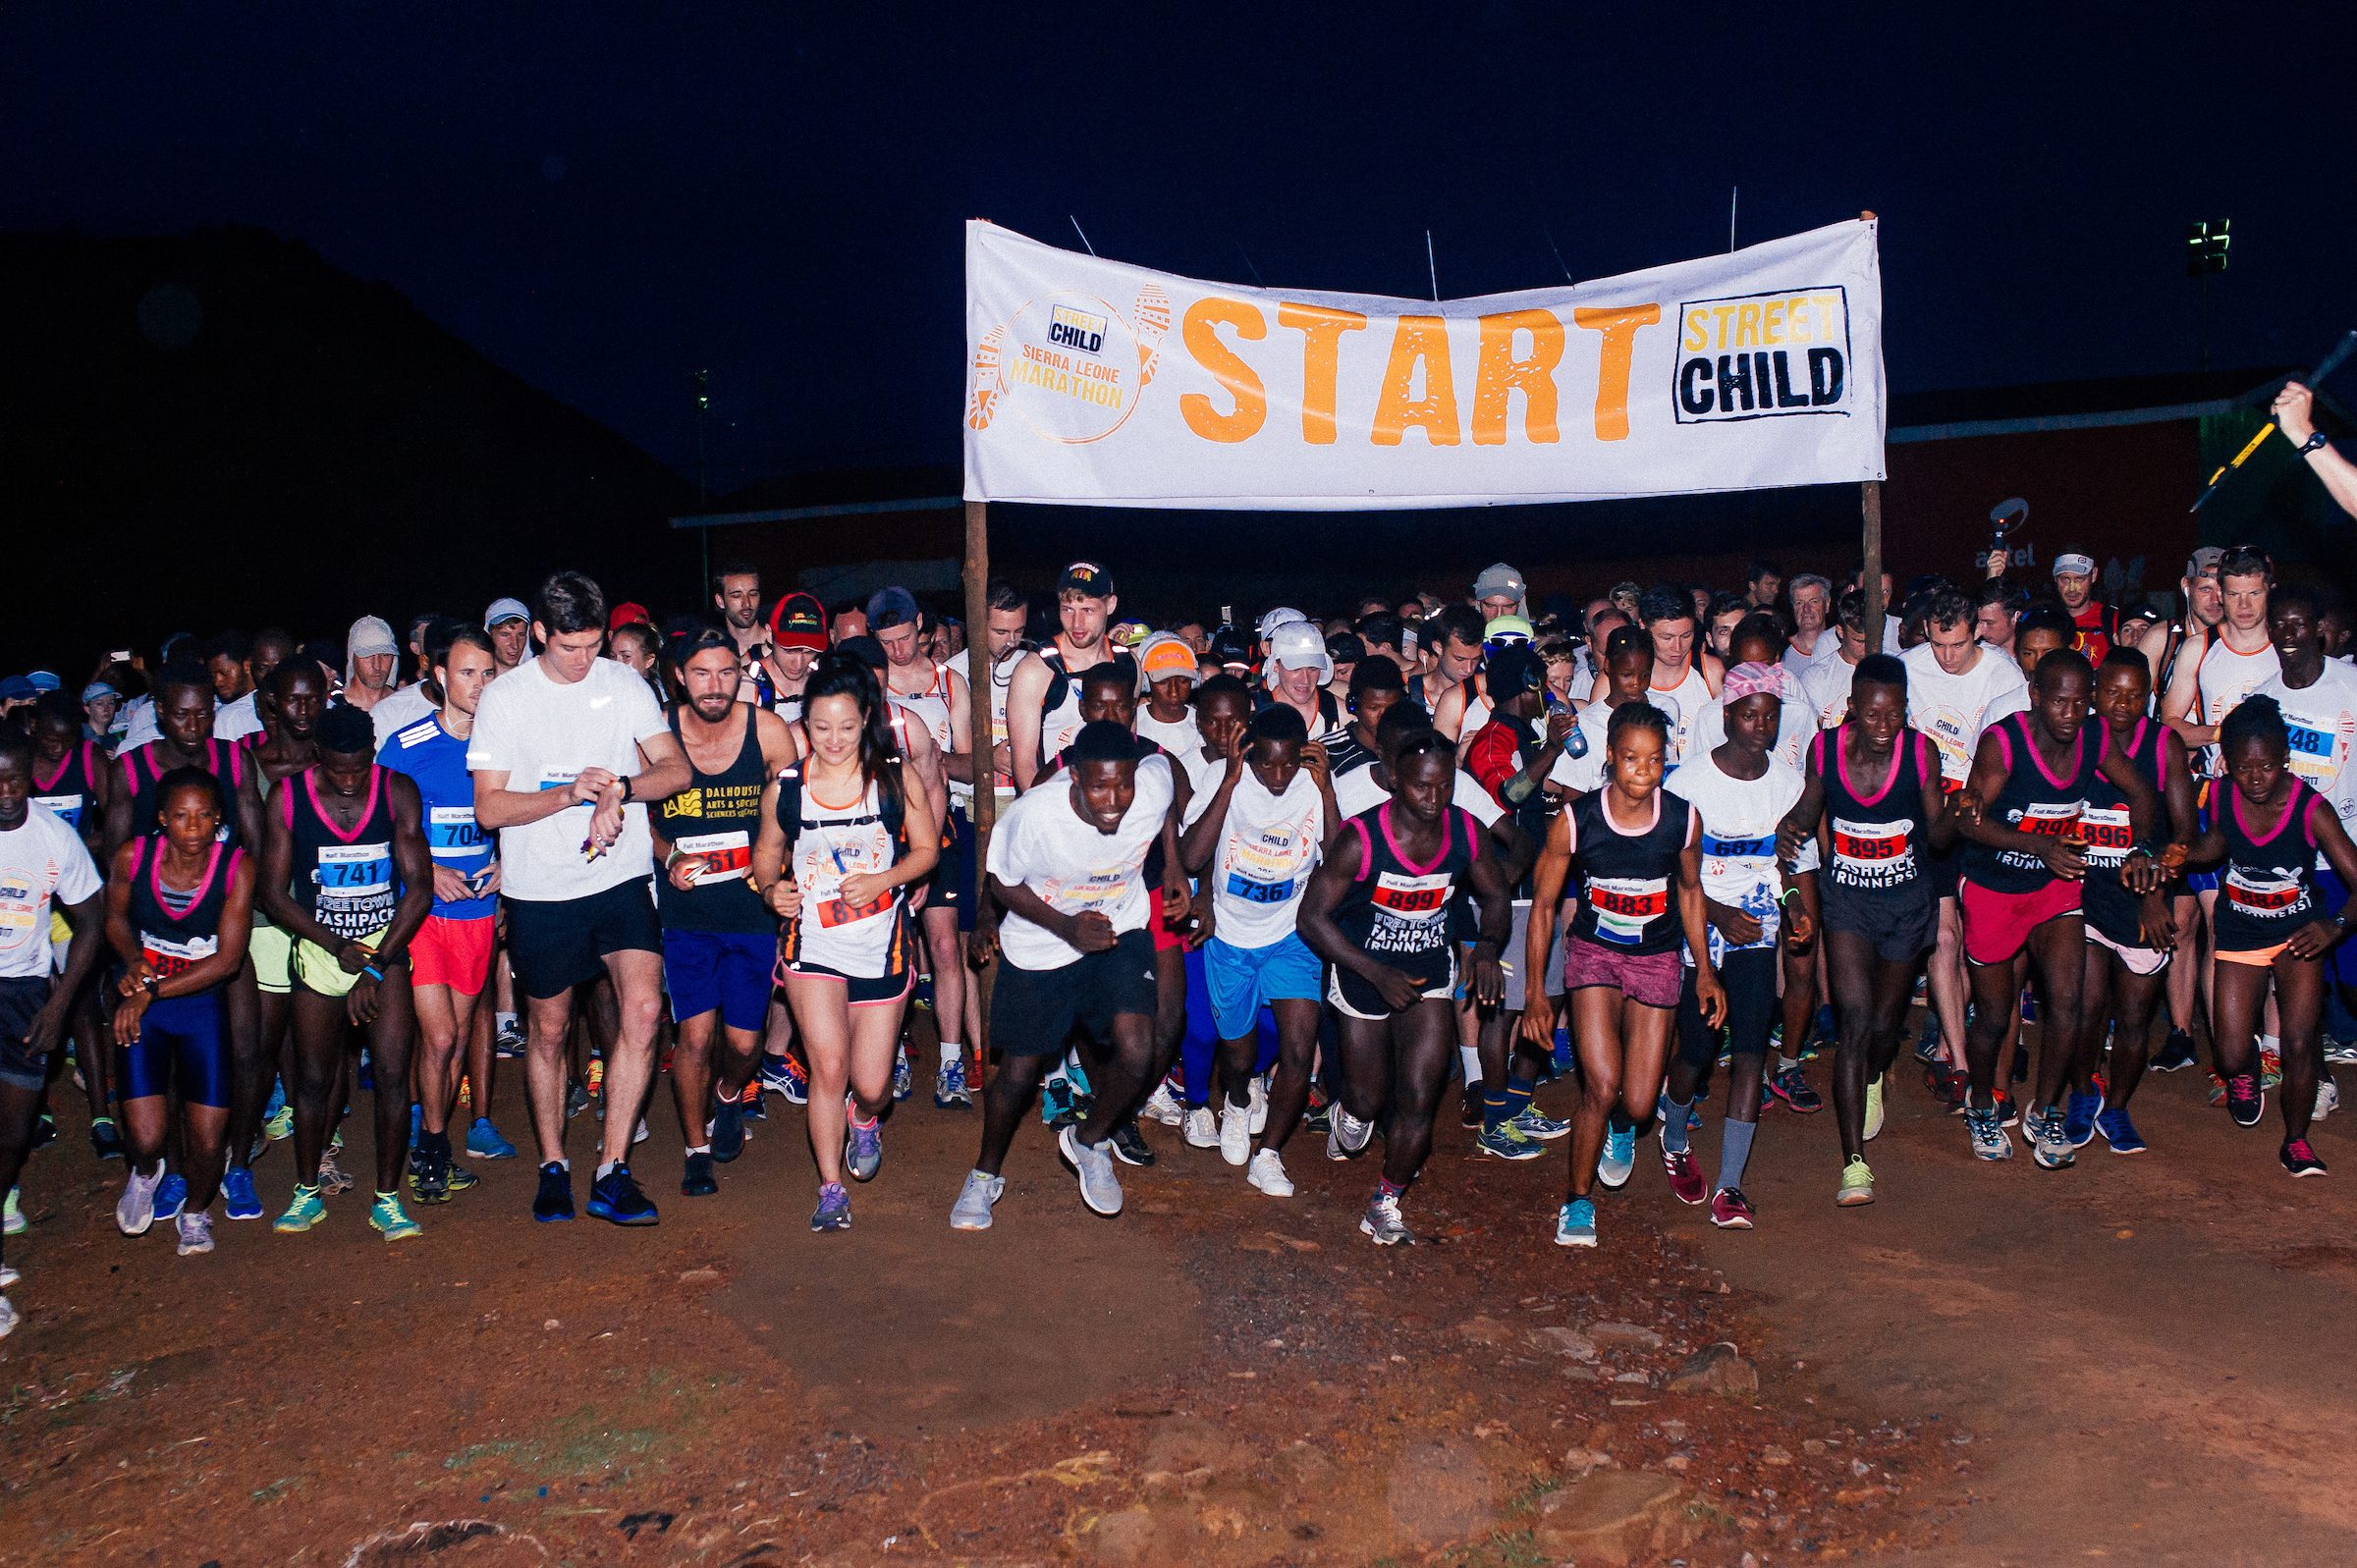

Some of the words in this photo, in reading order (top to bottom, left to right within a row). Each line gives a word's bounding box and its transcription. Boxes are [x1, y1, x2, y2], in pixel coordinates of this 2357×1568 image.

[1054, 307, 1104, 333] STREET
[1684, 297, 1838, 352] STREET
[1050, 322, 1102, 352] CHILD
[1022, 344, 1069, 371] SIERRA
[1075, 359, 1121, 384] LEONE
[1179, 297, 1661, 445] START
[1010, 356, 1124, 409] MARATHON
[1680, 348, 1843, 414] CHILD
[1975, 542, 2035, 568] atel
[1937, 719, 1959, 735] CHILD
[706, 785, 761, 798] DALHOUSIE
[706, 799, 726, 809] ARTS
[445, 824, 483, 846] 704
[1262, 834, 1288, 847] CHILD
[2083, 826, 2129, 846] 896
[1715, 840, 1764, 857] 687
[1847, 837, 1893, 859] 895
[707, 851, 736, 872] 61
[2001, 854, 2046, 870] RUNN
[334, 861, 378, 886] 741
[1240, 879, 1284, 902] 736
[1388, 892, 1435, 911] 899
[316, 892, 395, 912] FREETOWN
[1604, 892, 1653, 915] 883
[155, 955, 190, 975] 88
